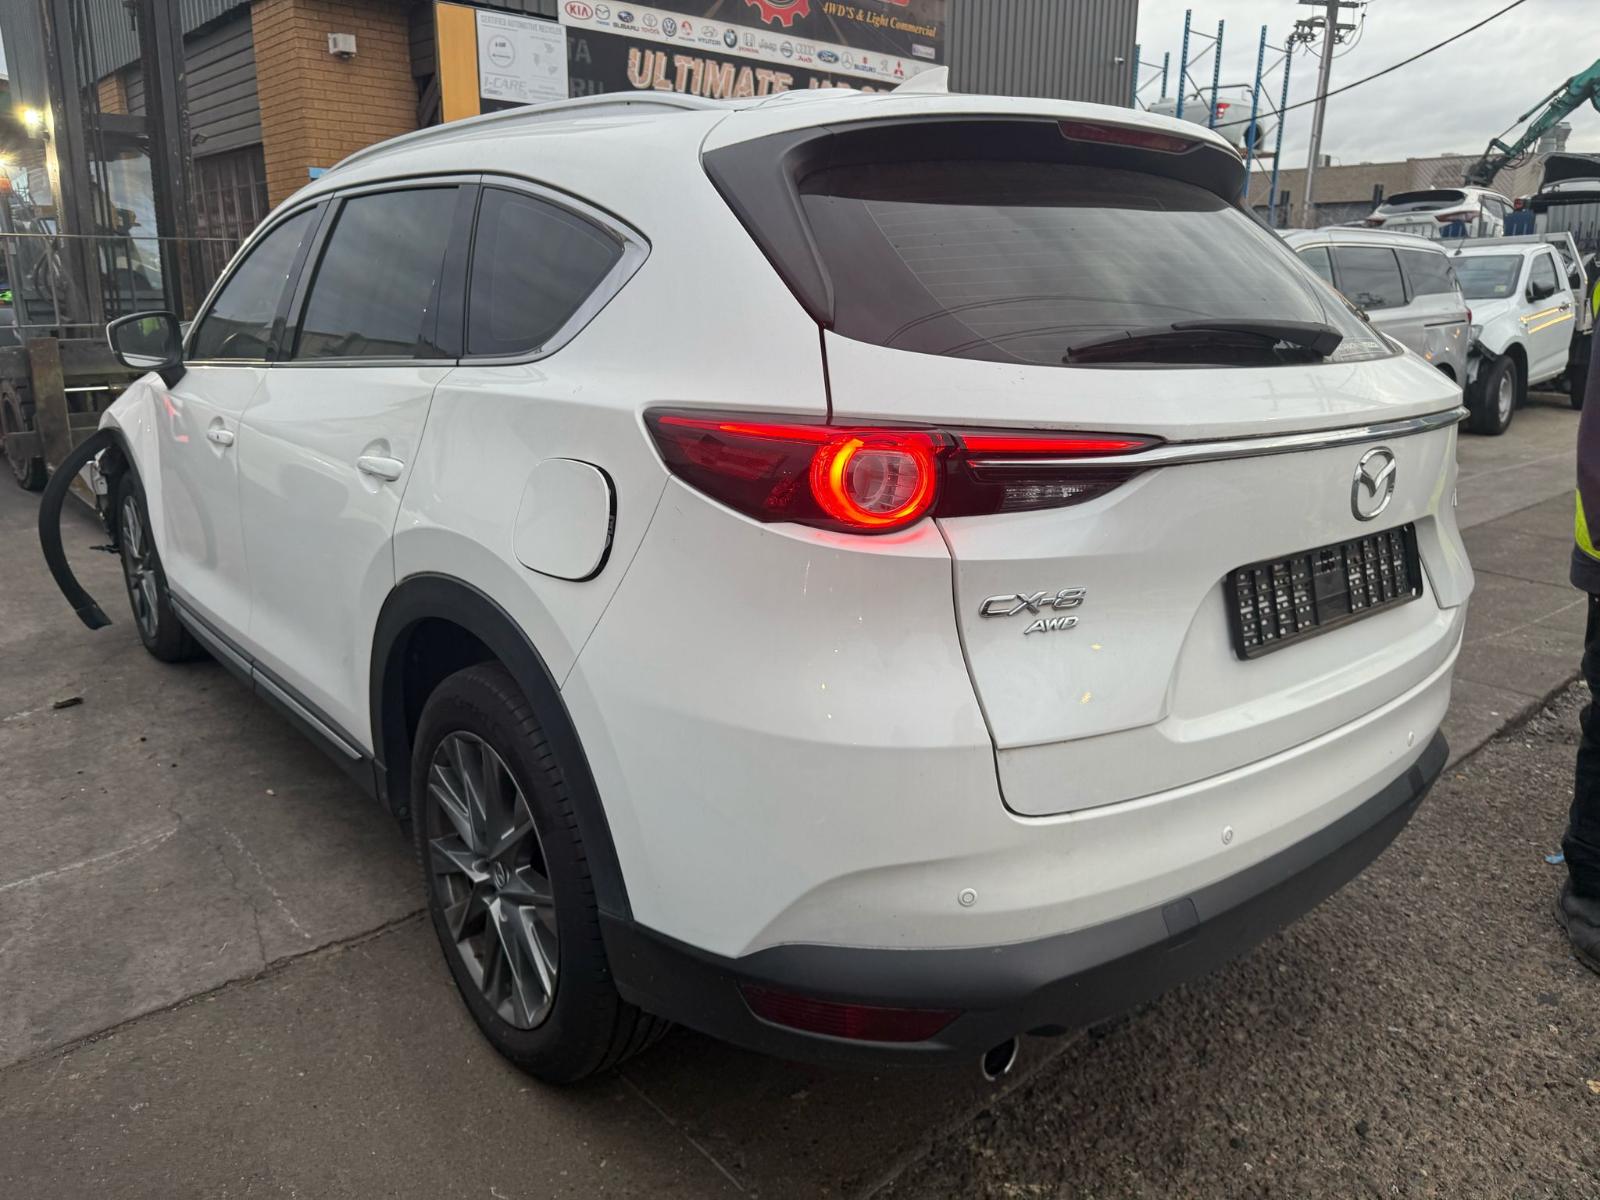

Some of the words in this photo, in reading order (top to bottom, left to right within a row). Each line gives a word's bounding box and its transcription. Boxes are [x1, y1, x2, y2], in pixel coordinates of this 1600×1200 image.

[569, 4, 589, 17] KIA
[612, 22, 640, 32] SUBARU
[856, 9, 865, 21] &
[866, 11, 888, 28] Light
[889, 16, 938, 38] Commercial
[627, 47, 794, 98] ULTIMATE
[978, 586, 1086, 618] CX-8
[1023, 615, 1079, 635] AWD
